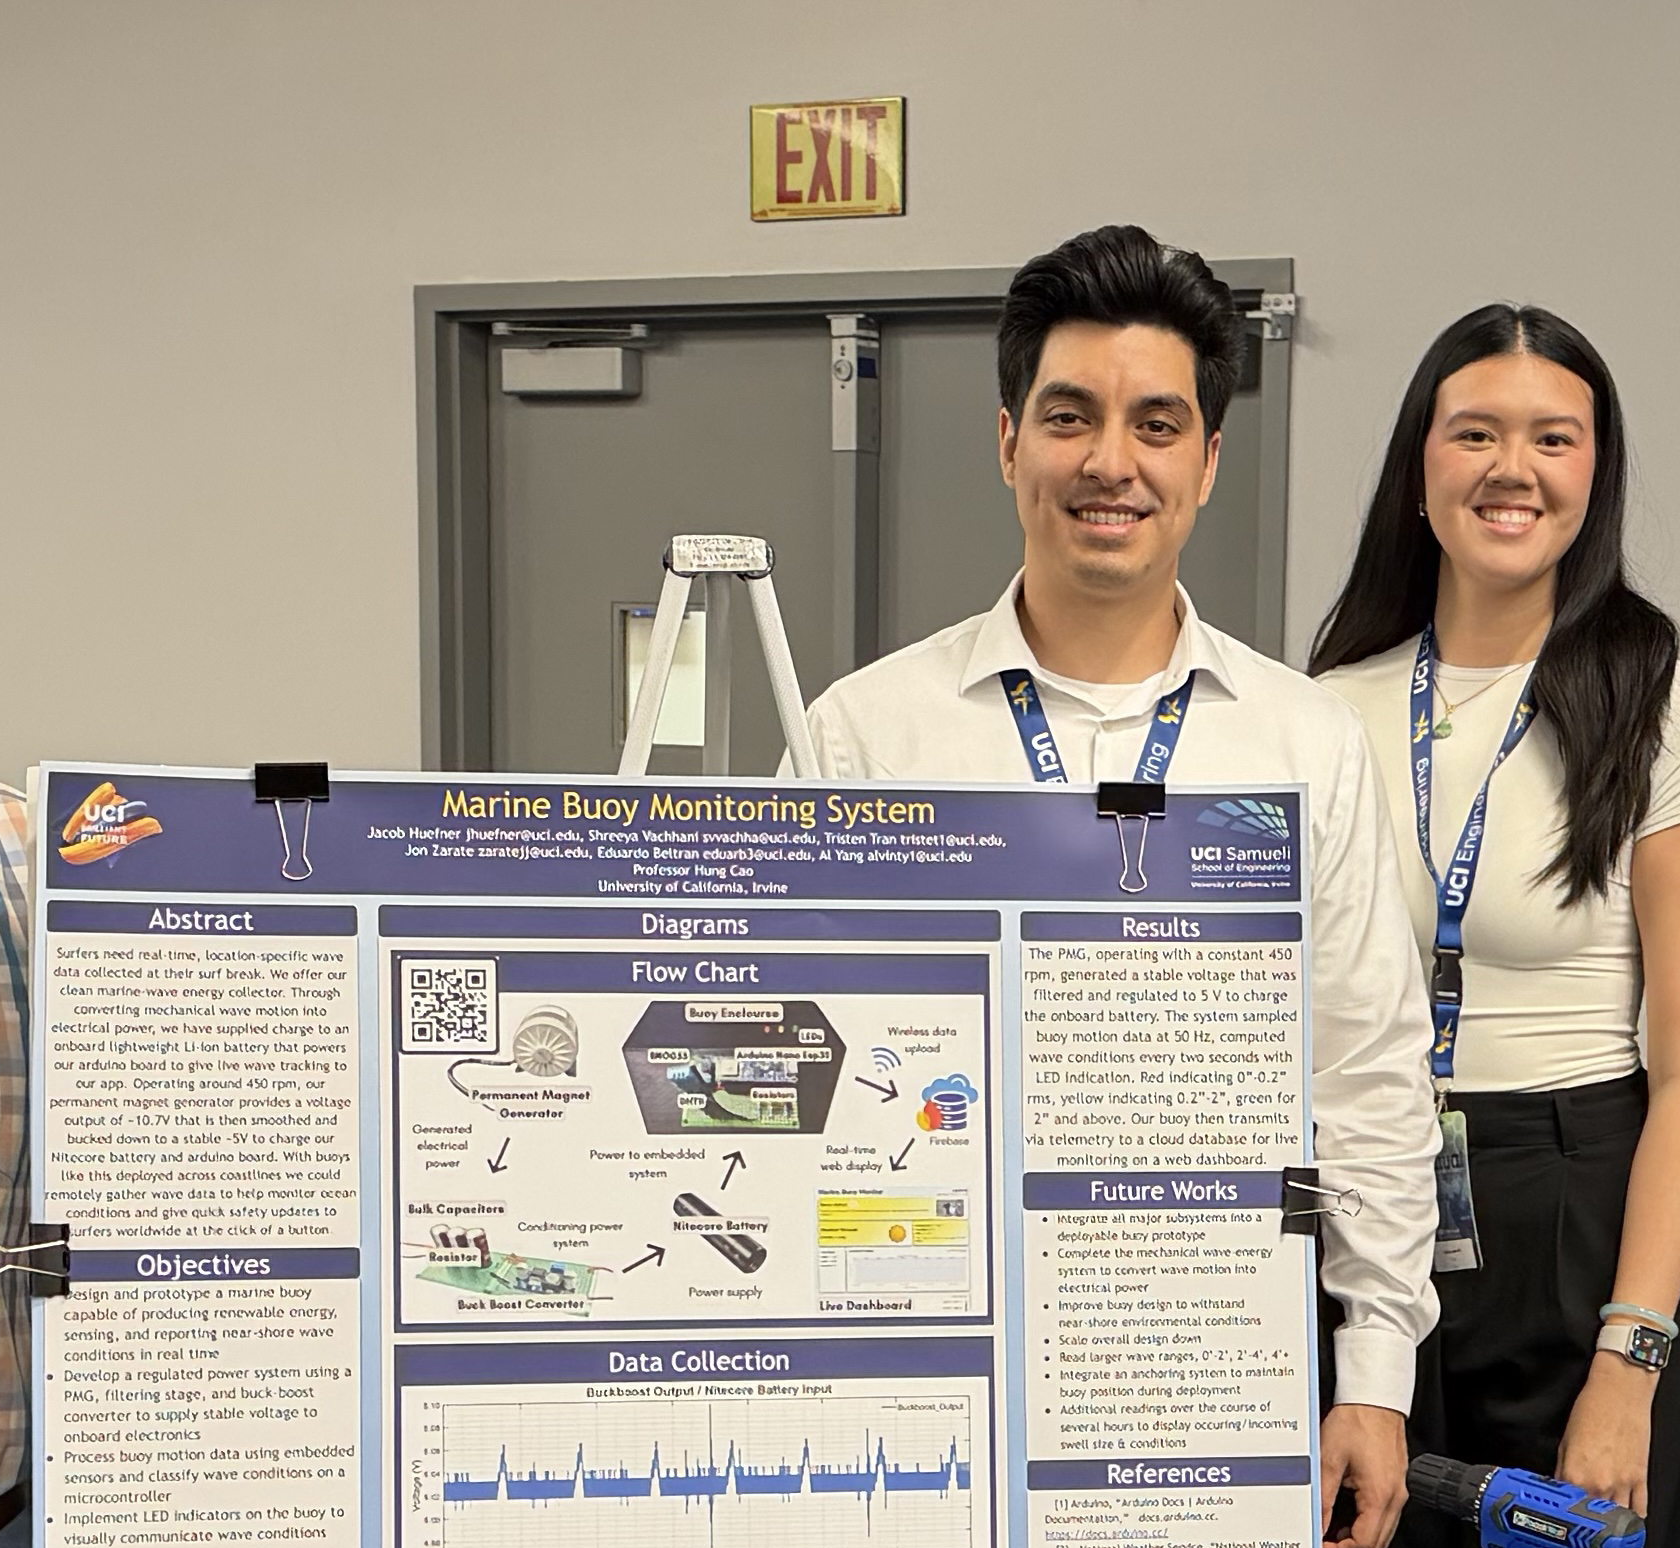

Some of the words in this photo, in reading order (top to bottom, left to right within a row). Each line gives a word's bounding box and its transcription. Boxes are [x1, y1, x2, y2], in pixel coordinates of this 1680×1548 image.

[776, 106, 887, 204] EXIT
[1413, 658, 1429, 695] UCI
[1031, 731, 1060, 773] UCI
[442, 789, 551, 818] Marine
[562, 791, 639, 826] Buoy
[649, 792, 817, 829] Monitoring
[826, 794, 935, 829] System
[81, 834, 128, 844] FUTURE
[367, 826, 406, 839] Jacob
[409, 827, 461, 841] Huefner
[465, 828, 584, 843] jhuefner@uci.edu,
[588, 830, 639, 844] Shreeya
[643, 830, 699, 844] Vachhani
[823, 832, 866, 845] Tristen
[869, 832, 897, 845] Tran
[405, 844, 428, 857] Jon
[432, 844, 474, 857] Zarate
[477, 845, 593, 861] zaratejj@uci.edu,
[597, 846, 649, 860] Eduardo
[653, 847, 700, 860] Beltran
[702, 848, 816, 863] eduarb3@uci.edu,
[836, 850, 864, 863] Yang
[867, 850, 973, 864] alvinty1@uci.edu
[1191, 847, 1222, 860] UCI
[1226, 846, 1291, 860] Samueli
[633, 863, 690, 877] Professor
[694, 865, 726, 879] Hung
[730, 865, 754, 877] Cao
[1191, 863, 1222, 872] School
[1224, 863, 1234, 871] of
[1236, 863, 1291, 872] Engineering
[598, 880, 663, 894] University
[665, 881, 679, 893] of
[682, 881, 749, 894] California,
[752, 881, 788, 894] Irvine
[1445, 868, 1470, 907] UCI
[148, 909, 254, 931] Abstract
[640, 912, 750, 940] Diagrams
[1123, 917, 1200, 938] Results
[1029, 948, 1053, 960] The
[1058, 948, 1091, 962] PMG,
[1096, 949, 1158, 964] operating
[1163, 949, 1191, 961] with
[1196, 951, 1203, 961] a
[1207, 949, 1264, 961] constant
[1269, 948, 1292, 961] 450
[632, 961, 687, 982] Flow
[695, 962, 760, 983] Chart
[1025, 971, 1056, 984] rpm,
[1061, 970, 1127, 983] generated
[1132, 972, 1139, 981] a
[1143, 970, 1183, 981] stable
[1187, 970, 1235, 983] voltage
[1240, 970, 1267, 981] that
[1272, 972, 1297, 981] was
[690, 1008, 718, 1019] Buoy
[887, 1026, 929, 1037] Wireless
[932, 1026, 957, 1037] data
[905, 1044, 940, 1055] upload
[472, 1090, 538, 1102] Permanent
[542, 1090, 591, 1103] Magnet
[499, 1109, 563, 1119] Generator
[412, 1125, 473, 1134] Generated
[417, 1141, 468, 1151] electrical
[929, 1136, 969, 1146] Firebase
[590, 1150, 625, 1160] Power
[629, 1150, 640, 1160] to
[643, 1149, 705, 1160] embedded
[826, 1146, 876, 1156] Real-time
[425, 1159, 460, 1170] power
[821, 1162, 843, 1171] web
[846, 1161, 883, 1173] display
[629, 1169, 667, 1181] system
[1090, 1181, 1164, 1201] Future
[1172, 1181, 1238, 1200] Works
[408, 1204, 433, 1214] Bulk
[437, 1204, 504, 1216] Capacitors
[518, 1222, 586, 1234] Conditioning
[590, 1223, 623, 1233] power
[726, 1221, 768, 1233] Battery
[553, 1239, 589, 1250] system
[429, 1252, 477, 1262] Resistor
[137, 1254, 271, 1280] Objectives
[688, 1287, 724, 1297] Power
[727, 1288, 763, 1300] supply
[458, 1300, 484, 1310] Buck
[490, 1300, 521, 1310] Boost
[525, 1300, 585, 1310] Converter
[819, 1301, 844, 1311] Live
[847, 1300, 912, 1310] Dashboard
[609, 1350, 665, 1374] Data
[671, 1350, 790, 1374] Collection
[586, 1386, 651, 1398] Buckboost
[654, 1386, 694, 1398] Output
[757, 1384, 799, 1398] Battery
[802, 1383, 833, 1396] Input
[1107, 1463, 1232, 1484] References
